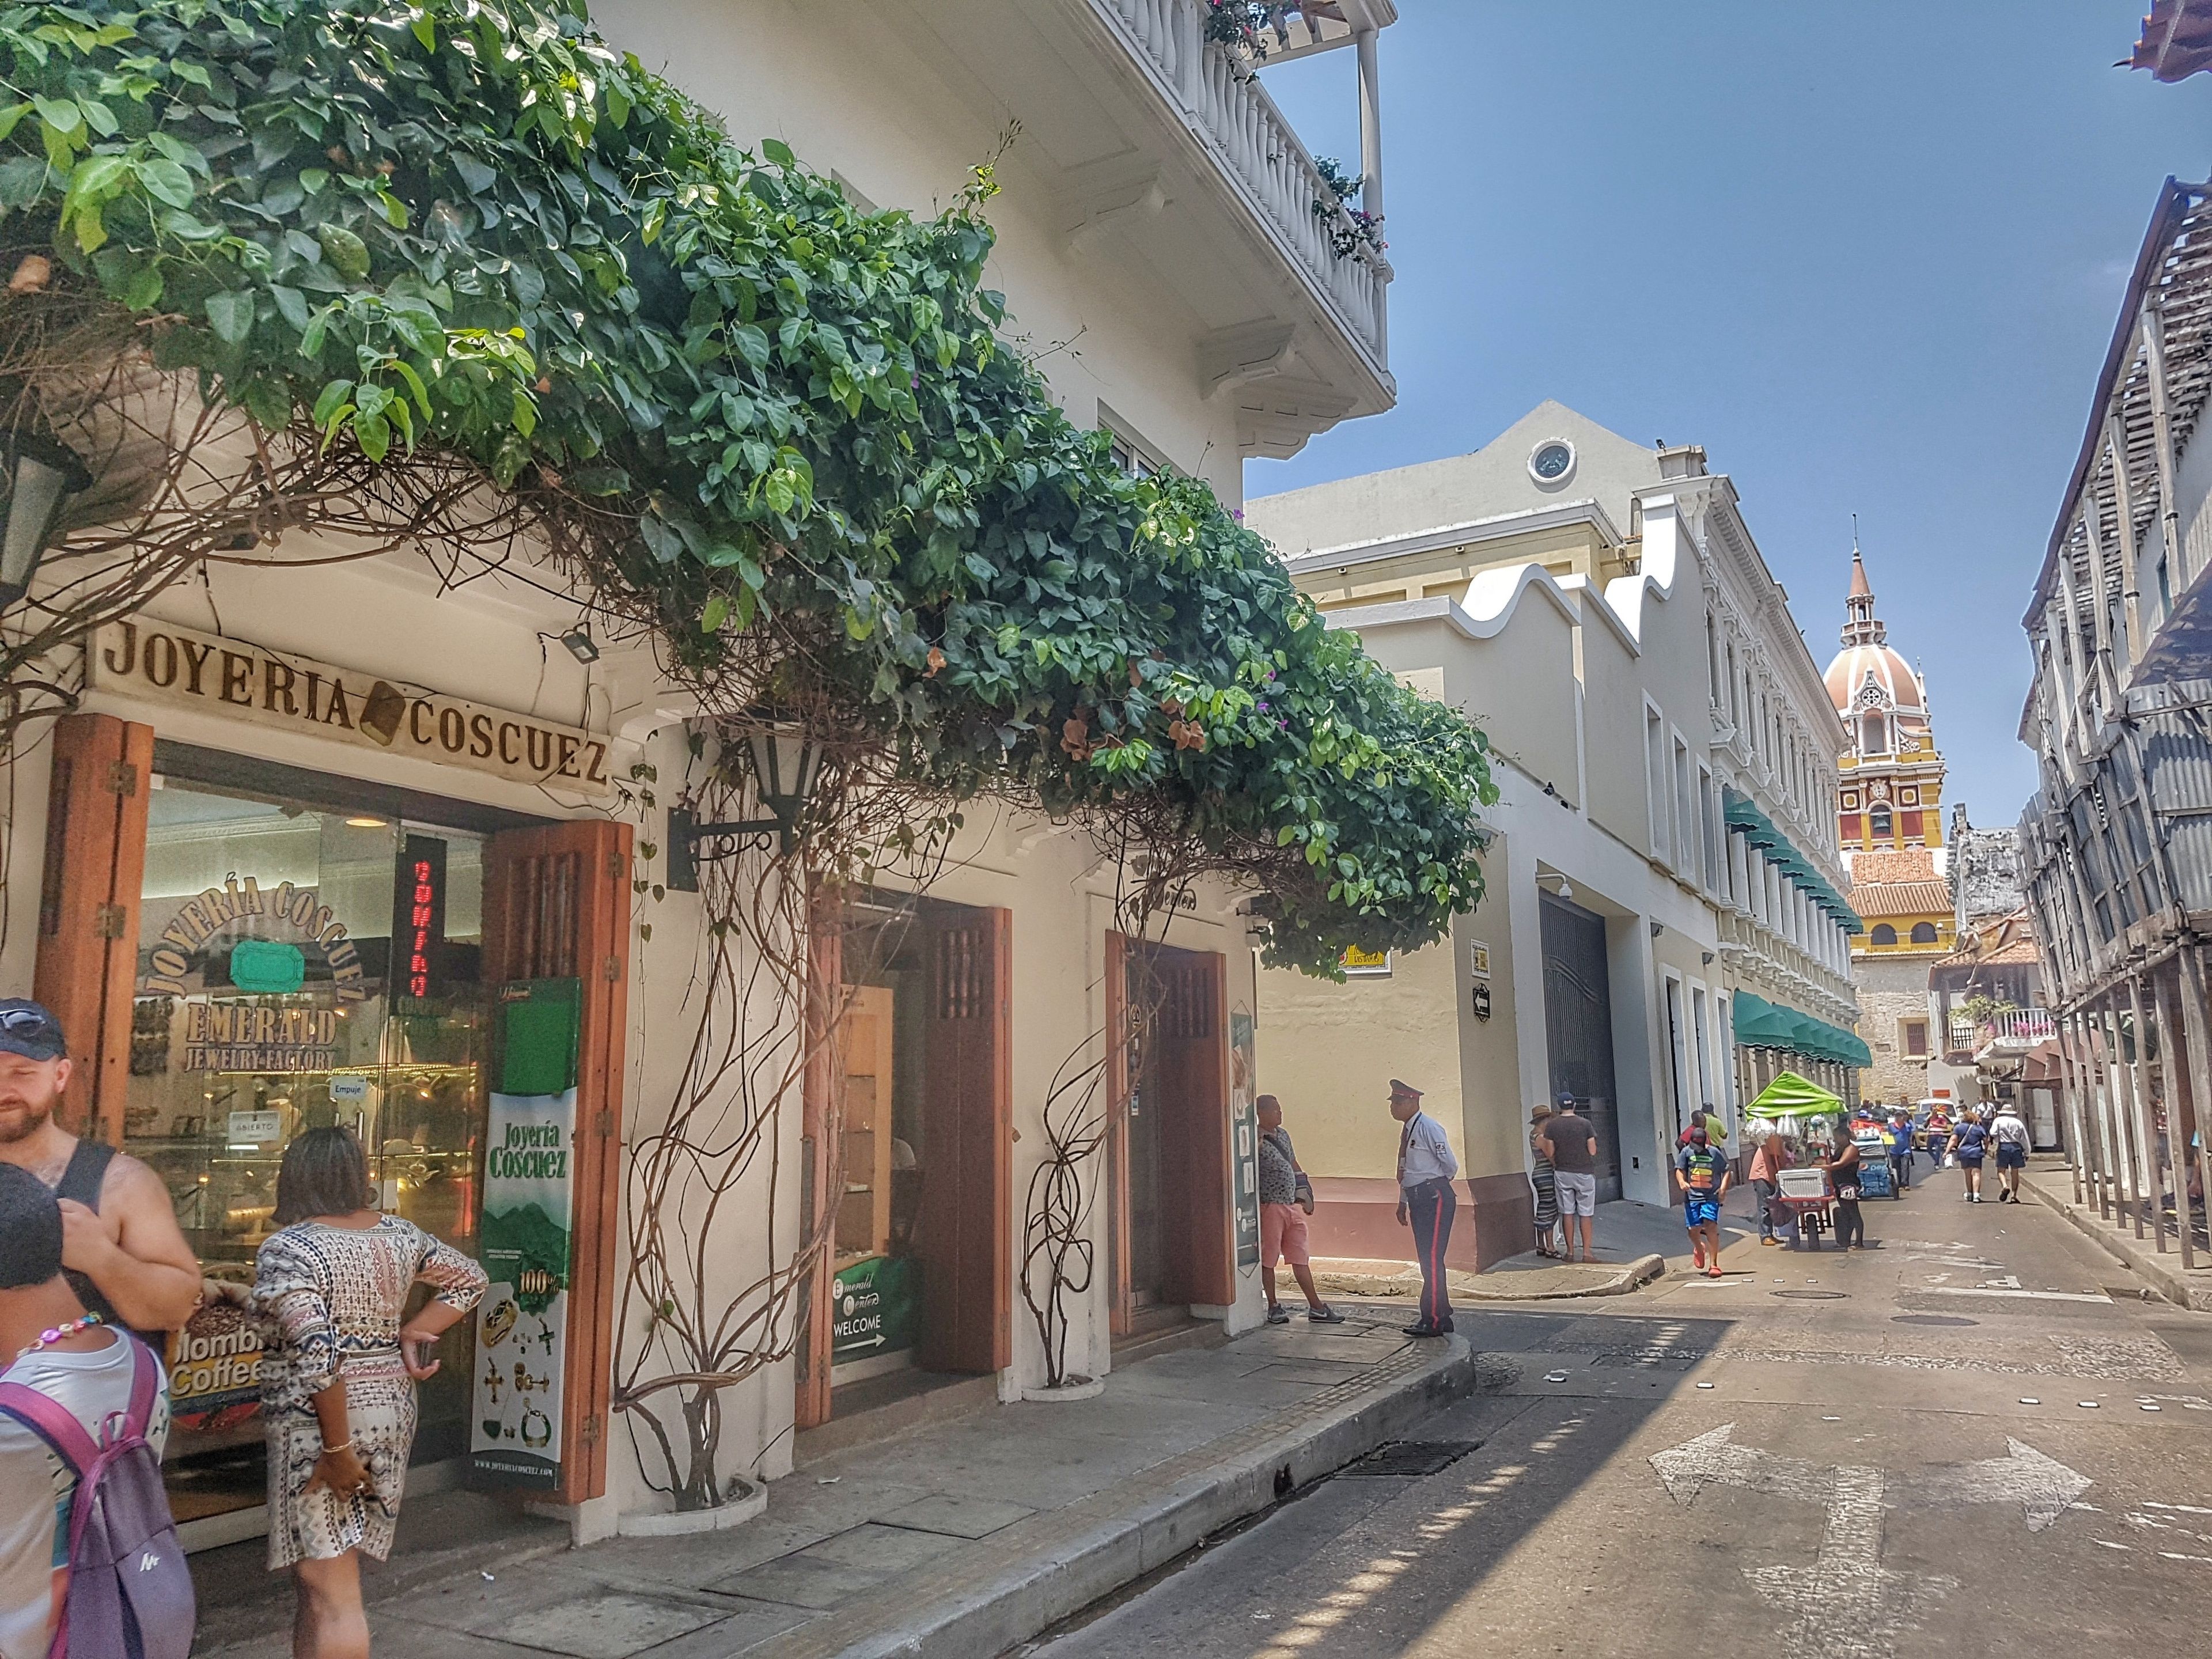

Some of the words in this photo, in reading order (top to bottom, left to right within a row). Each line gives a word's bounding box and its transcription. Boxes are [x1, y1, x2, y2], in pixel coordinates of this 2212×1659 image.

[104, 619, 354, 728] JOYERIA
[410, 698, 608, 785] COSCUEZ
[1164, 884, 1196, 911] enter
[145, 871, 263, 999] JOYERÍA
[275, 881, 366, 1003] COSCUEZ
[186, 1002, 336, 1045] EMERALD
[335, 1085, 362, 1094] Empuje
[236, 1123, 274, 1131] ABIERTO
[504, 1120, 559, 1150] Joyería
[489, 1145, 566, 1179] Coscuez
[519, 1268, 559, 1294] 100%
[834, 1272, 874, 1297] Emerald
[845, 1292, 879, 1314] Center
[834, 1315, 881, 1338] WELCOME
[175, 1325, 263, 1364] lomb
